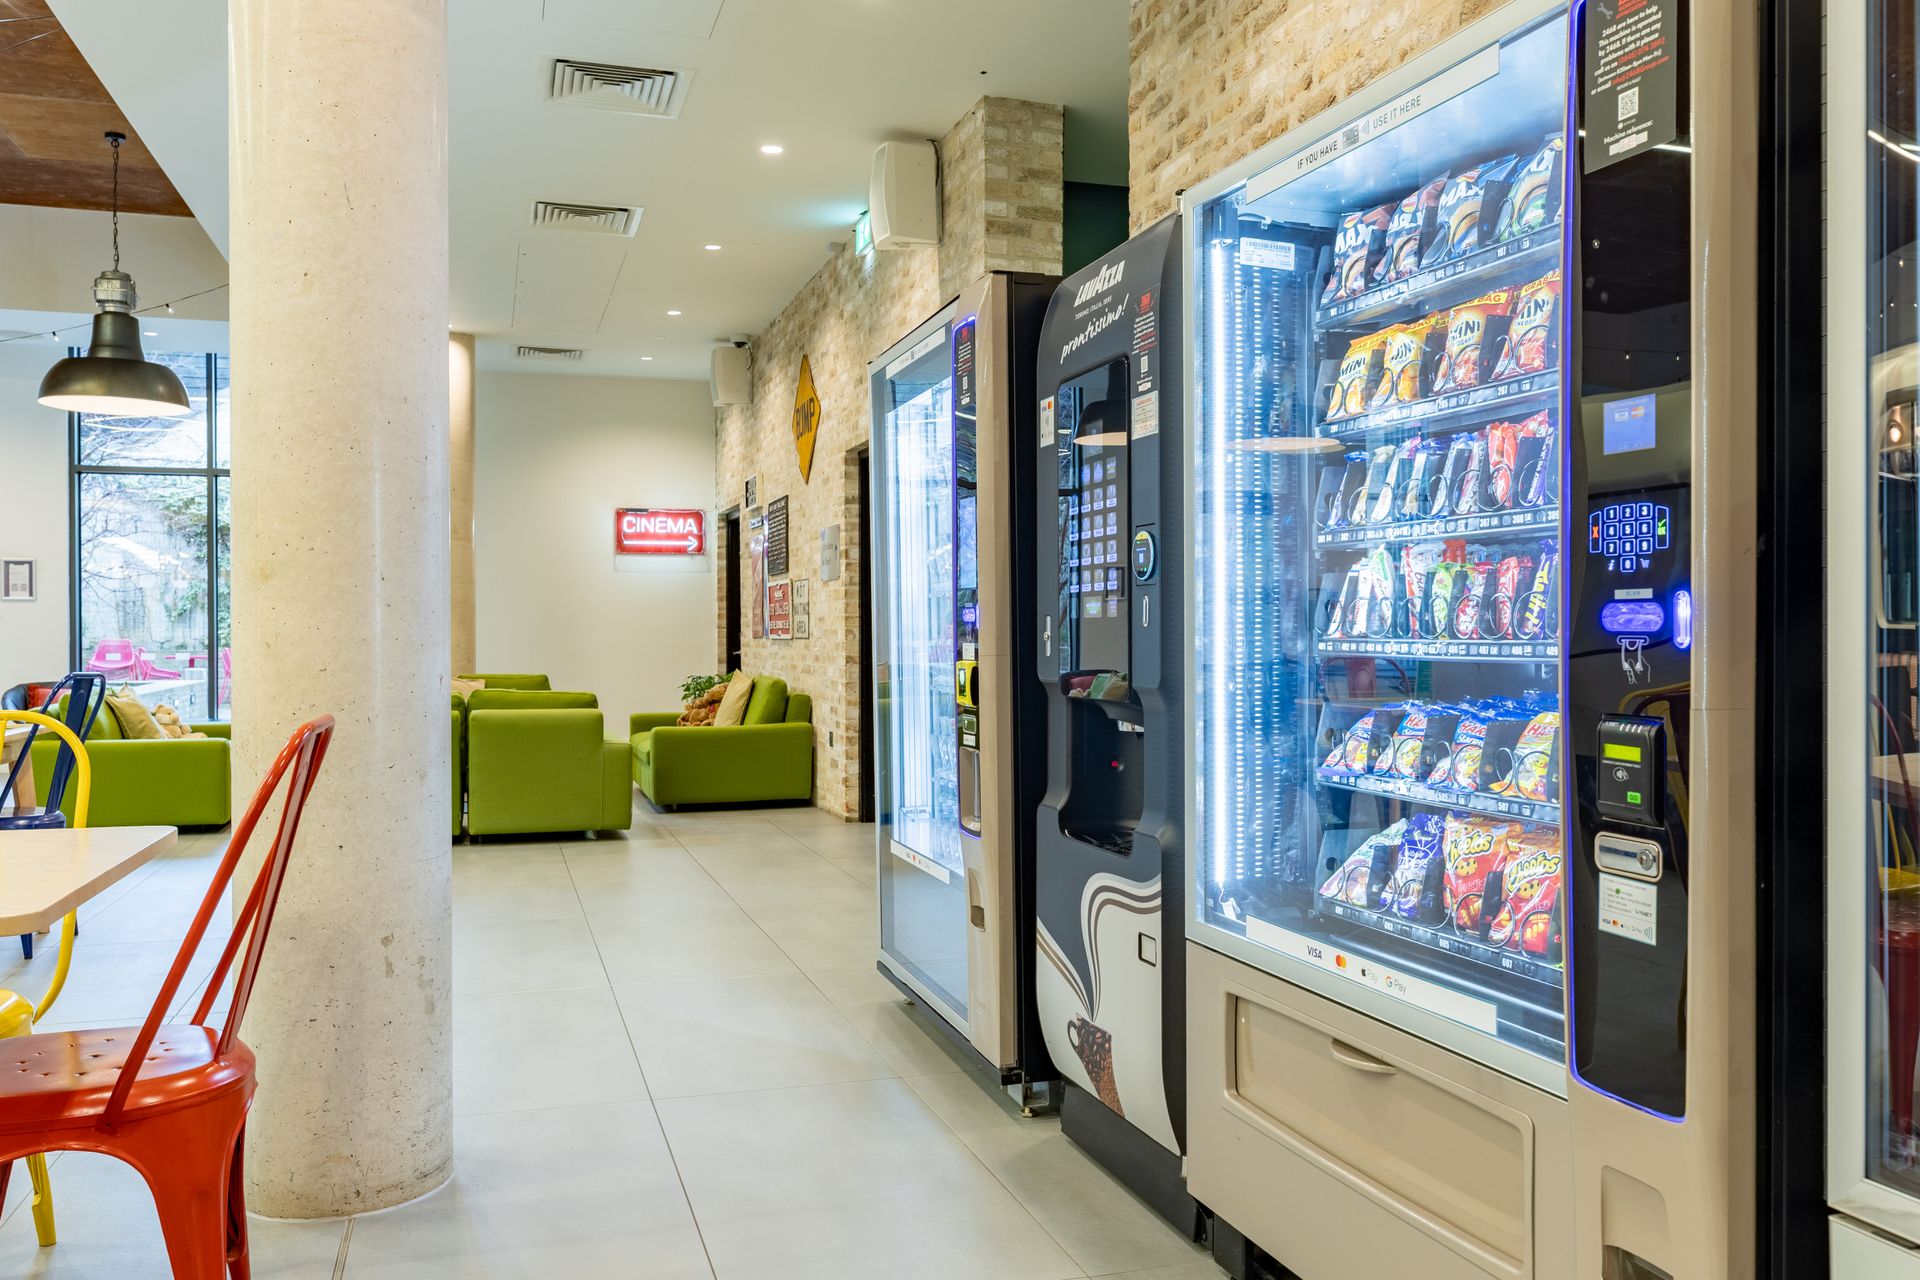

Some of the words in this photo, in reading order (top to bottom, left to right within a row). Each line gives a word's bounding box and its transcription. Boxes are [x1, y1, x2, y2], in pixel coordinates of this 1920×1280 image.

[1297, 158, 1304, 170] IF
[1304, 152, 1318, 166] YOU
[1320, 139, 1338, 158] HAVE
[1373, 113, 1388, 129] USE
[1390, 108, 1398, 120] IT
[1399, 95, 1422, 115] HERE
[1073, 260, 1126, 308] LAVAZZA
[622, 516, 698, 535] CINEMA
[1307, 945, 1323, 961] VISA
[1394, 979, 1407, 995] Pay
